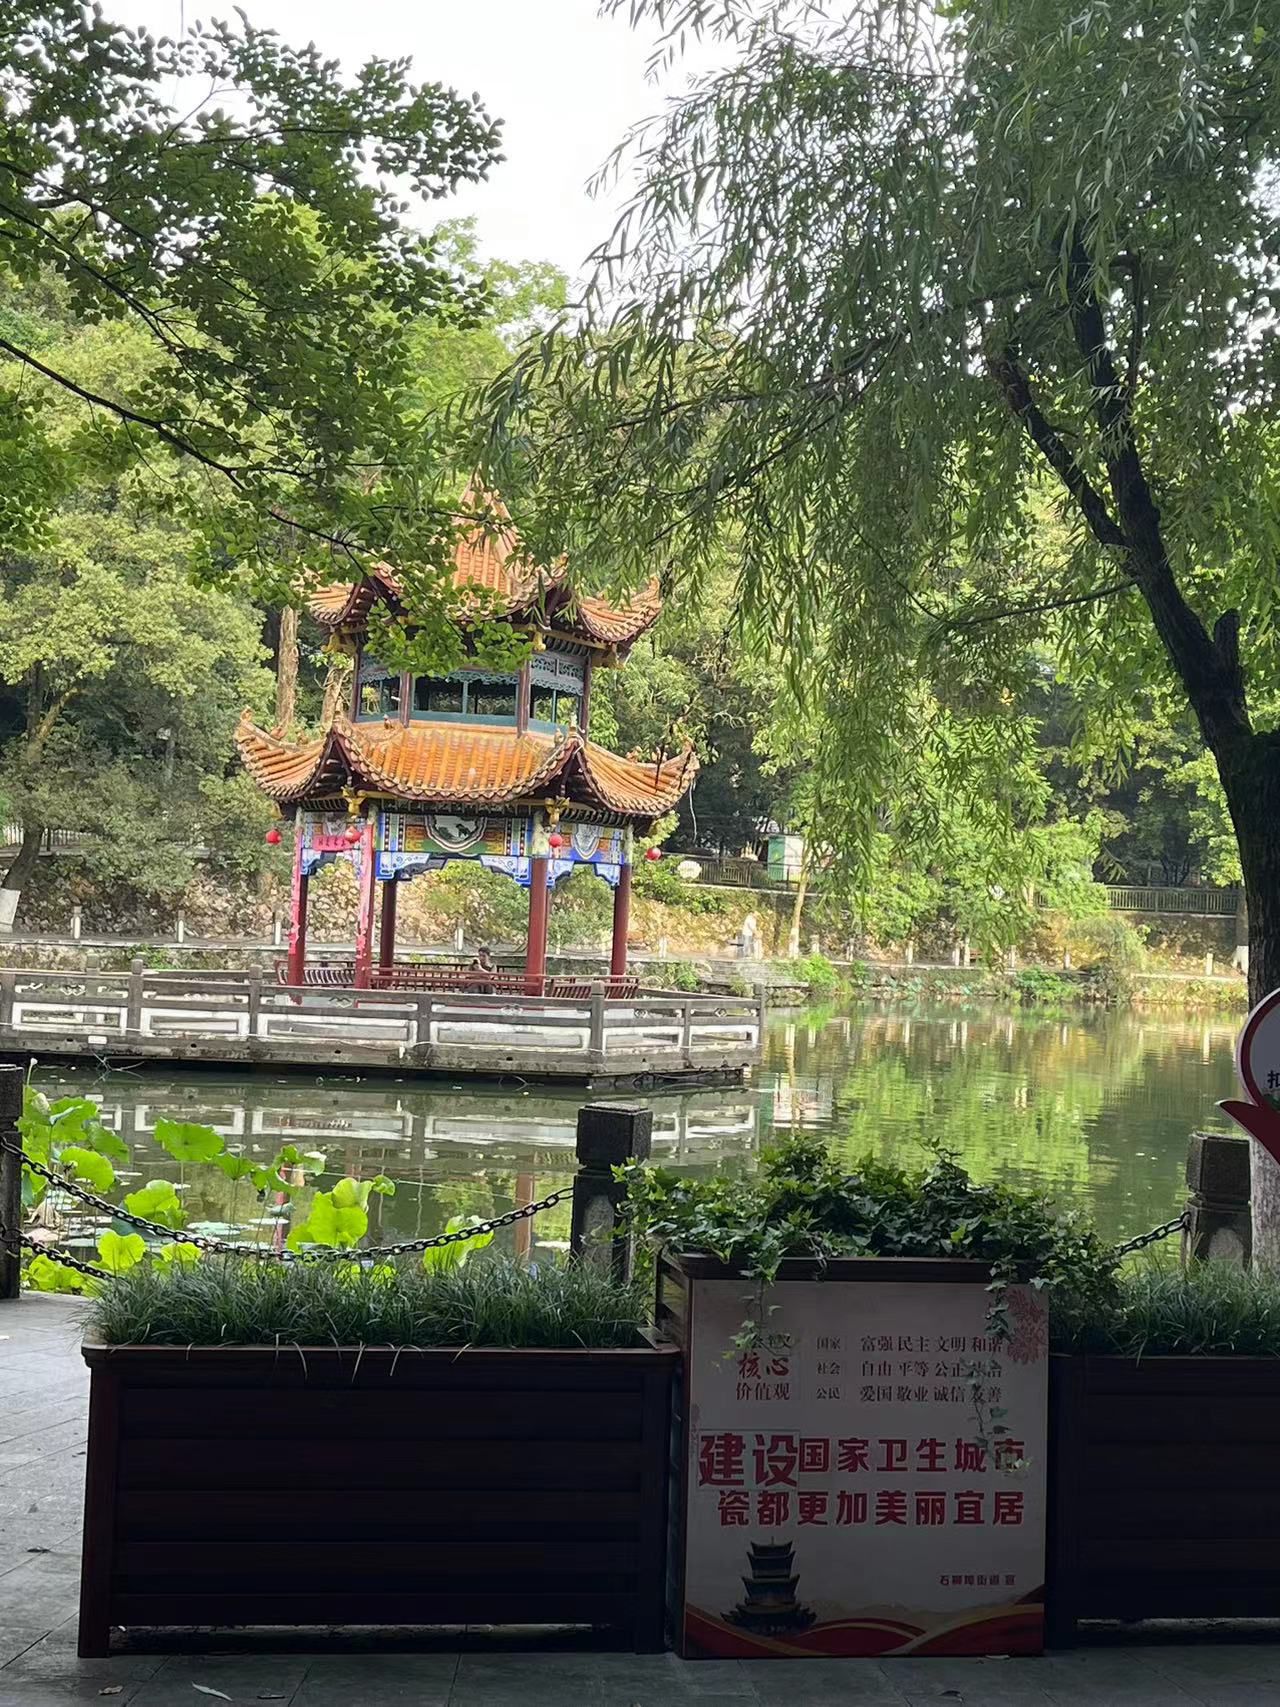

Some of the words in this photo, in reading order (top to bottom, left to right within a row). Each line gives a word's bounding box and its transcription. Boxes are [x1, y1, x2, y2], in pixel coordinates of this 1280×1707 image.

[816, 1337, 841, 1351] 国家
[737, 1353, 790, 1379] 核心
[816, 1362, 841, 1376] 社会
[736, 1383, 790, 1401] 价值观
[816, 1386, 841, 1400] 公民
[718, 1490, 1025, 1527] 瓷都更加美丽宜居
